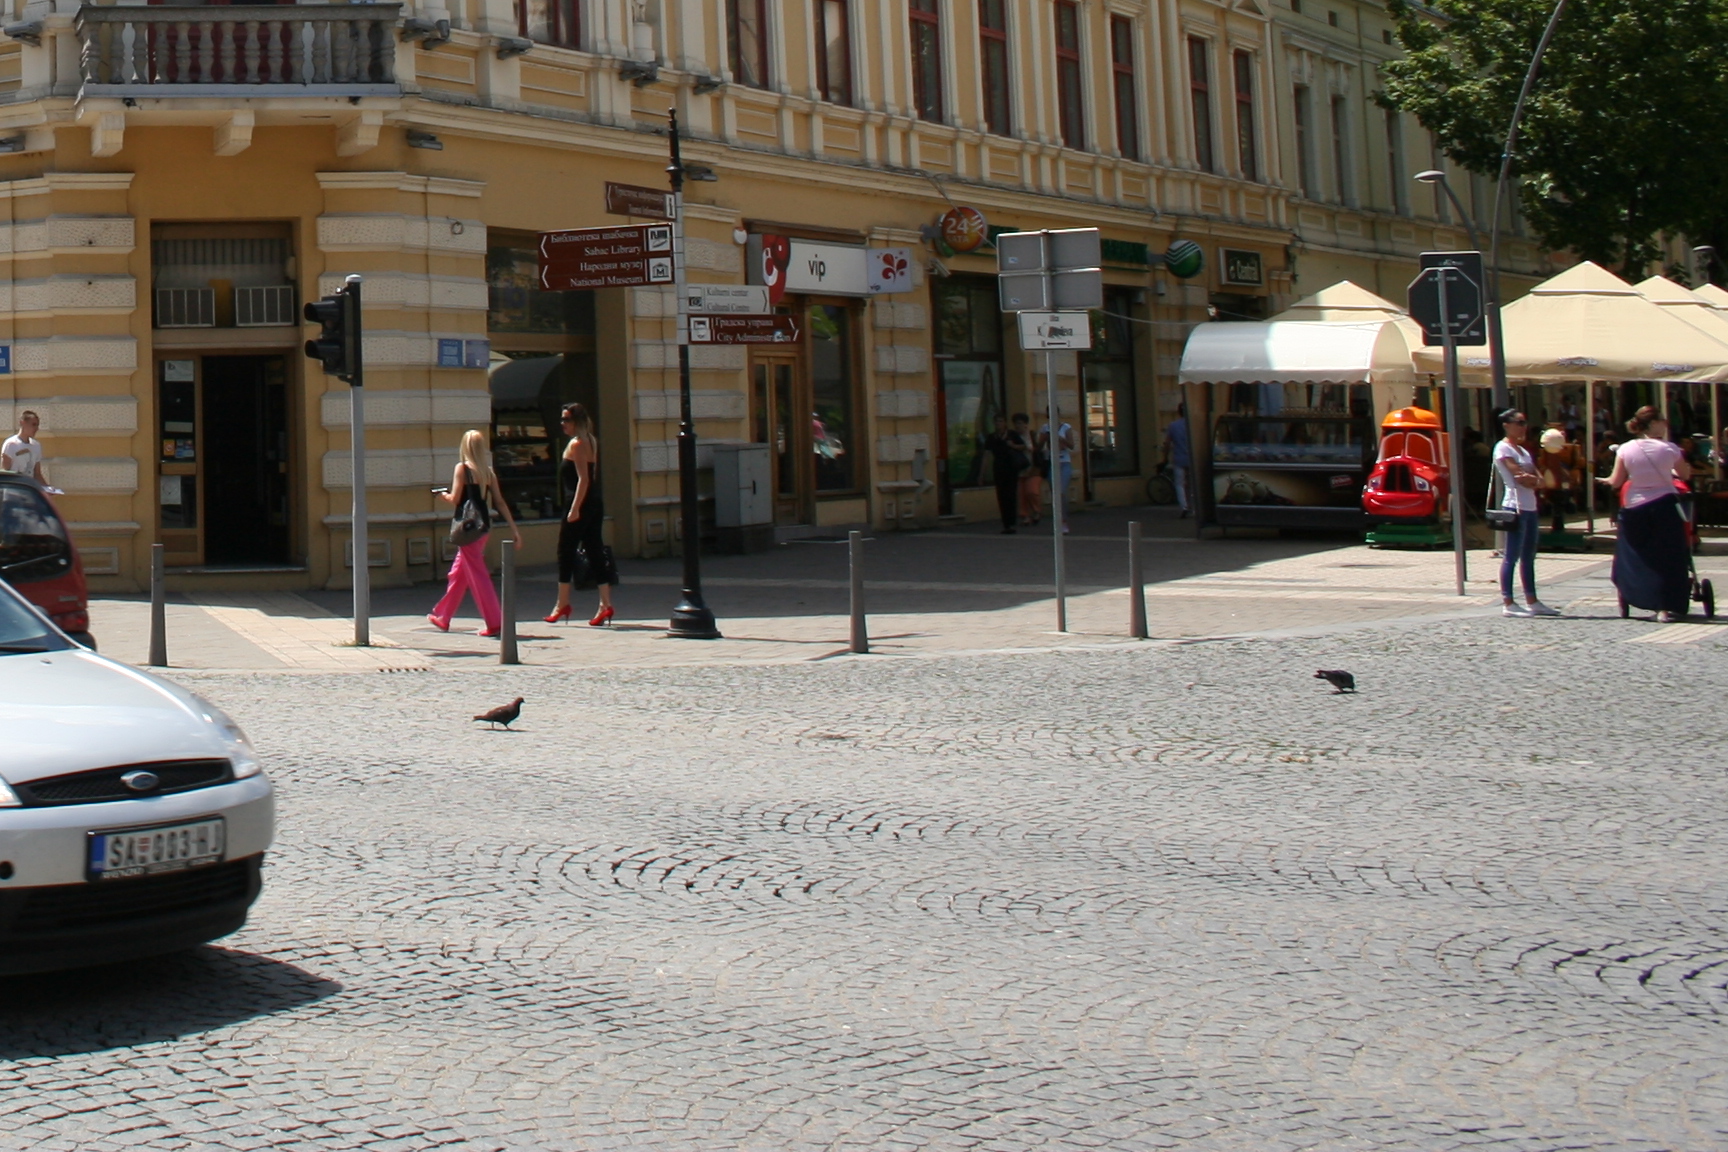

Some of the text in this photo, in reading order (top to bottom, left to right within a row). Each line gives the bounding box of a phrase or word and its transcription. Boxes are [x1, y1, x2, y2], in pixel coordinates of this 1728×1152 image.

[946, 217, 969, 234] 24
[551, 233, 600, 244] Библиотека
[611, 245, 642, 255] Library
[580, 262, 618, 273] Народни
[808, 254, 826, 282] vip
[570, 275, 643, 288] National Museum
[717, 333, 735, 344] City
[109, 836, 137, 868] SA
